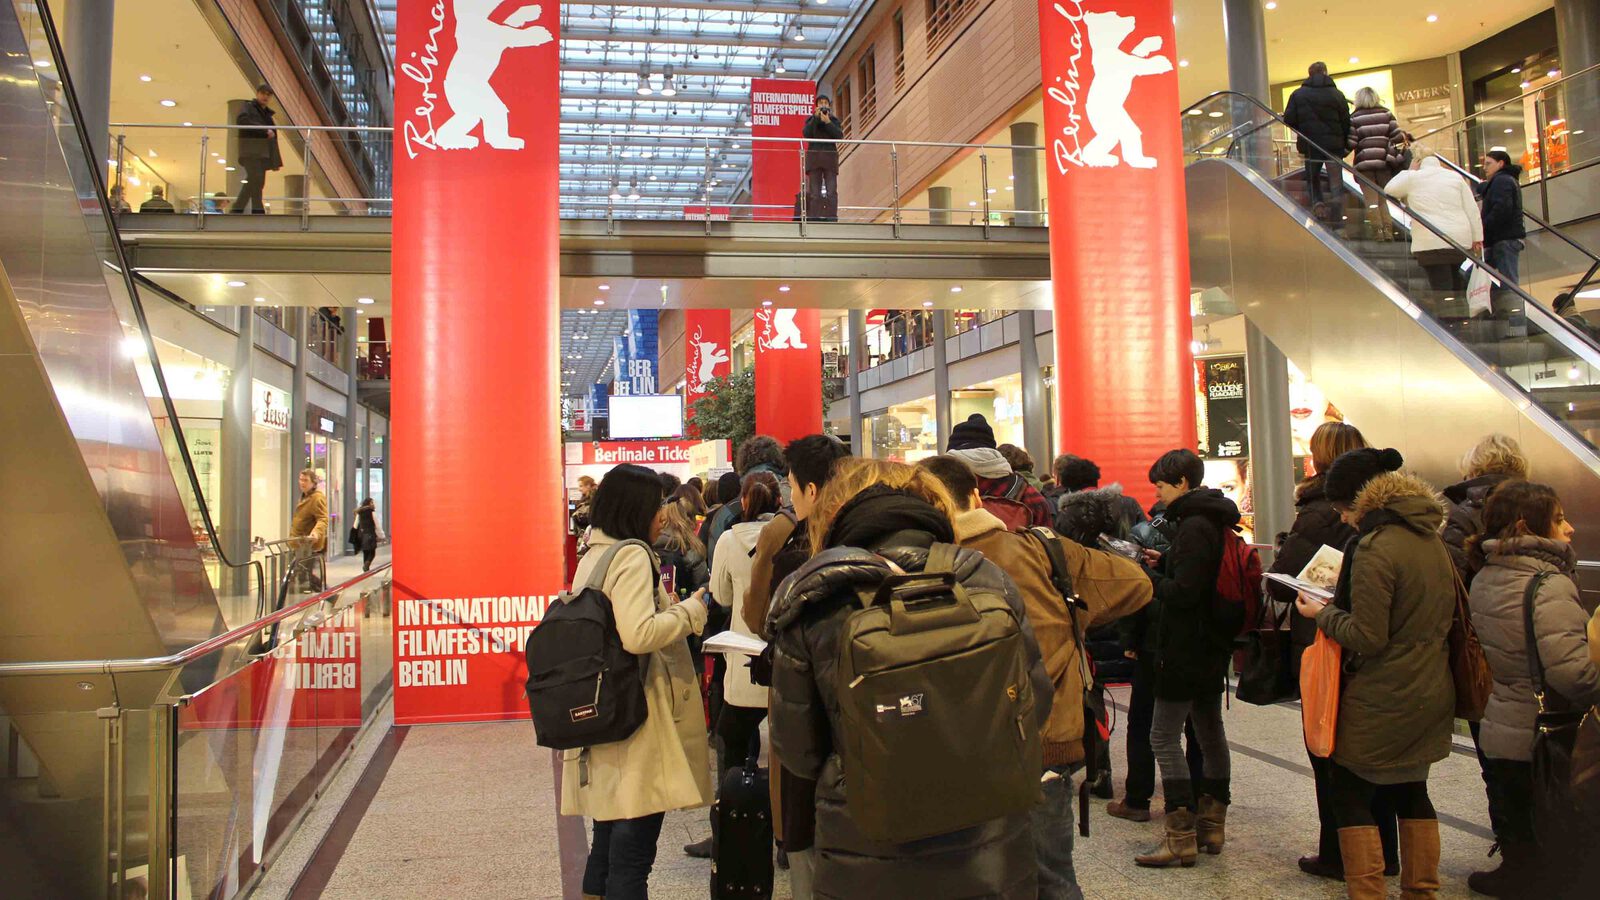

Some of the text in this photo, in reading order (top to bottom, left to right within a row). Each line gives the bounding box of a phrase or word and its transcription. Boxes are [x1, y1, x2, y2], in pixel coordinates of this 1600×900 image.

[1048, 0, 1084, 175] Berlinal
[753, 92, 815, 104] INTERNATIONALE
[753, 104, 813, 115] FILMFESTSPIELE
[753, 115, 780, 126] BERLIN
[628, 360, 652, 377] BER
[686, 324, 703, 396] Berlinale
[632, 376, 655, 394] LIN
[595, 446, 655, 462] Berlinale
[398, 595, 558, 626] INTERNATIONAL
[398, 659, 468, 688] BERLIN
